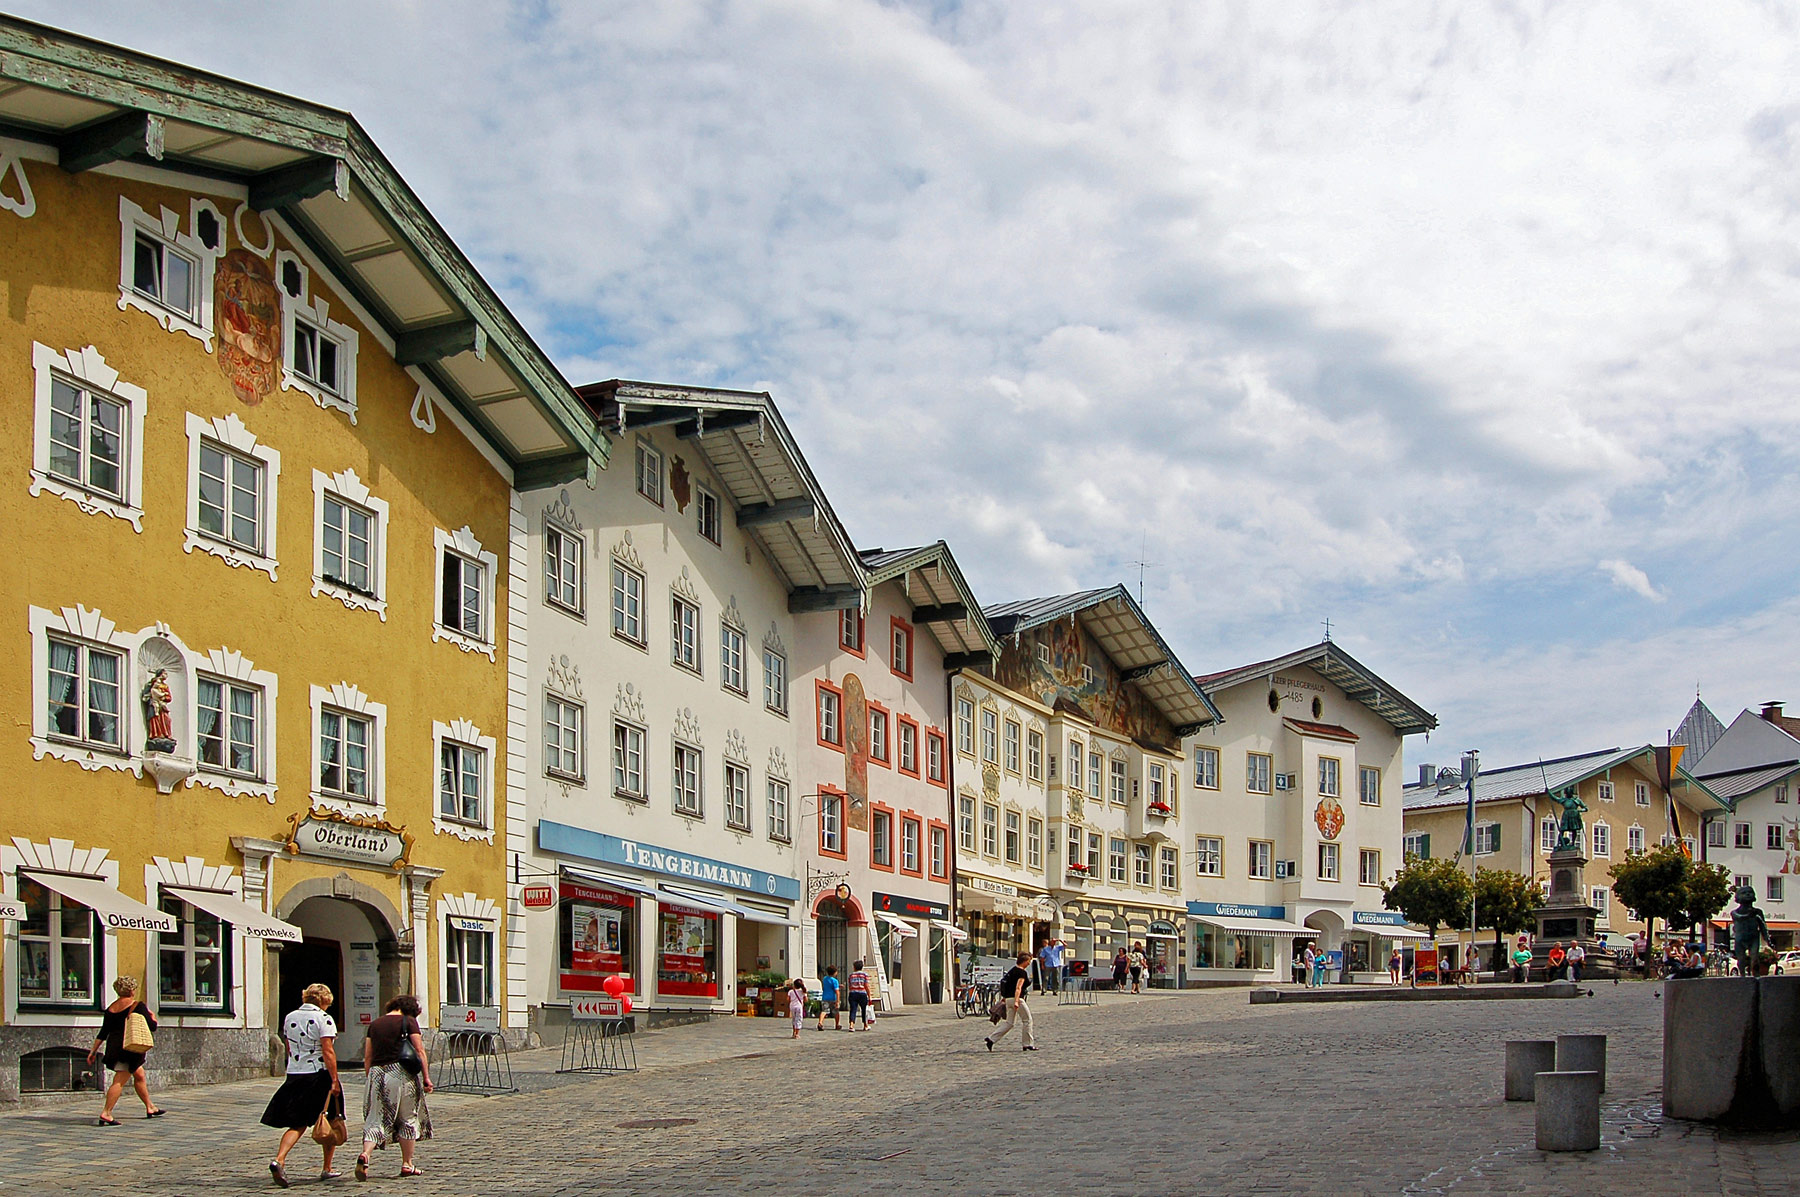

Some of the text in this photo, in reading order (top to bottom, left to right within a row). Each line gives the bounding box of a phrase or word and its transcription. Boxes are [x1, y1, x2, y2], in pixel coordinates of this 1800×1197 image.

[1287, 691, 1304, 703] 1485
[314, 827, 389, 853] Oberland
[621, 840, 752, 888] TENGELMANN
[525, 888, 550, 899] WITT
[574, 887, 614, 902] TENGELMANN
[0, 905, 16, 917] ke
[108, 913, 170, 931] Oberland
[461, 919, 484, 930] basic
[246, 926, 296, 939] Apotheke
